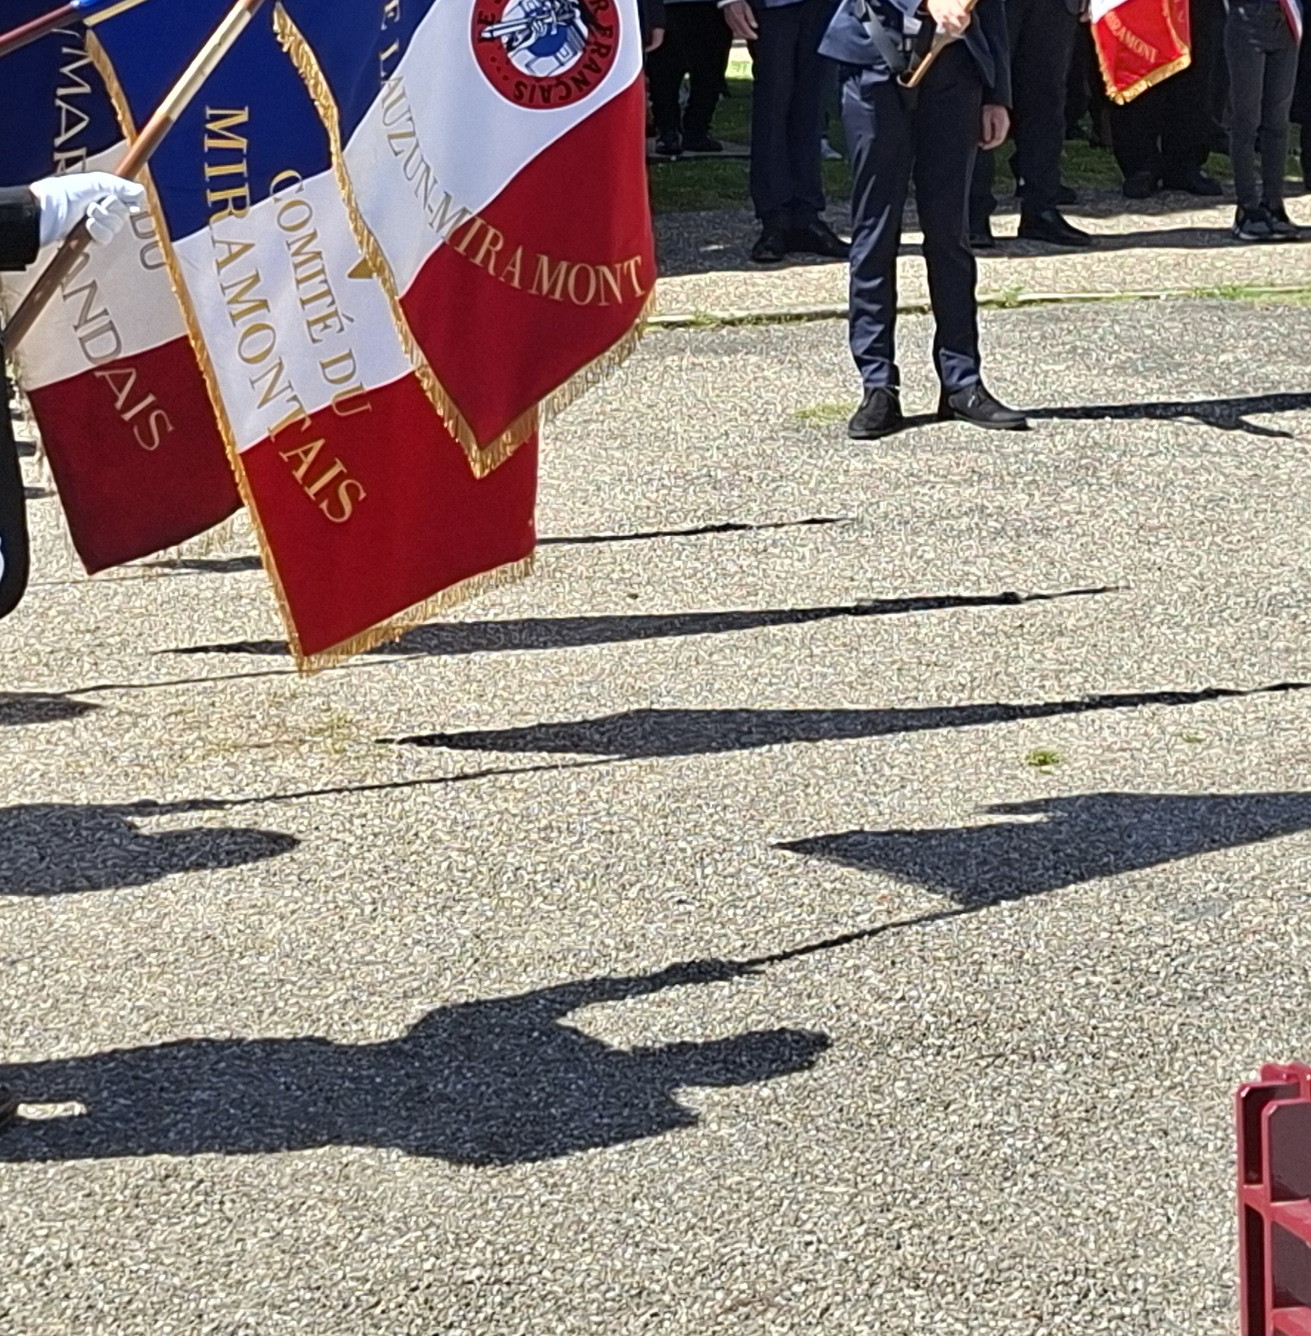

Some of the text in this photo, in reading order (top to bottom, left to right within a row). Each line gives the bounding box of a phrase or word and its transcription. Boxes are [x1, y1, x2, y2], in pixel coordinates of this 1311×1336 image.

[513, 22, 615, 105] FRANÇAIS
[204, 106, 367, 524] MIRAMONTAIS
[270, 168, 372, 418] COMITÉ DU
